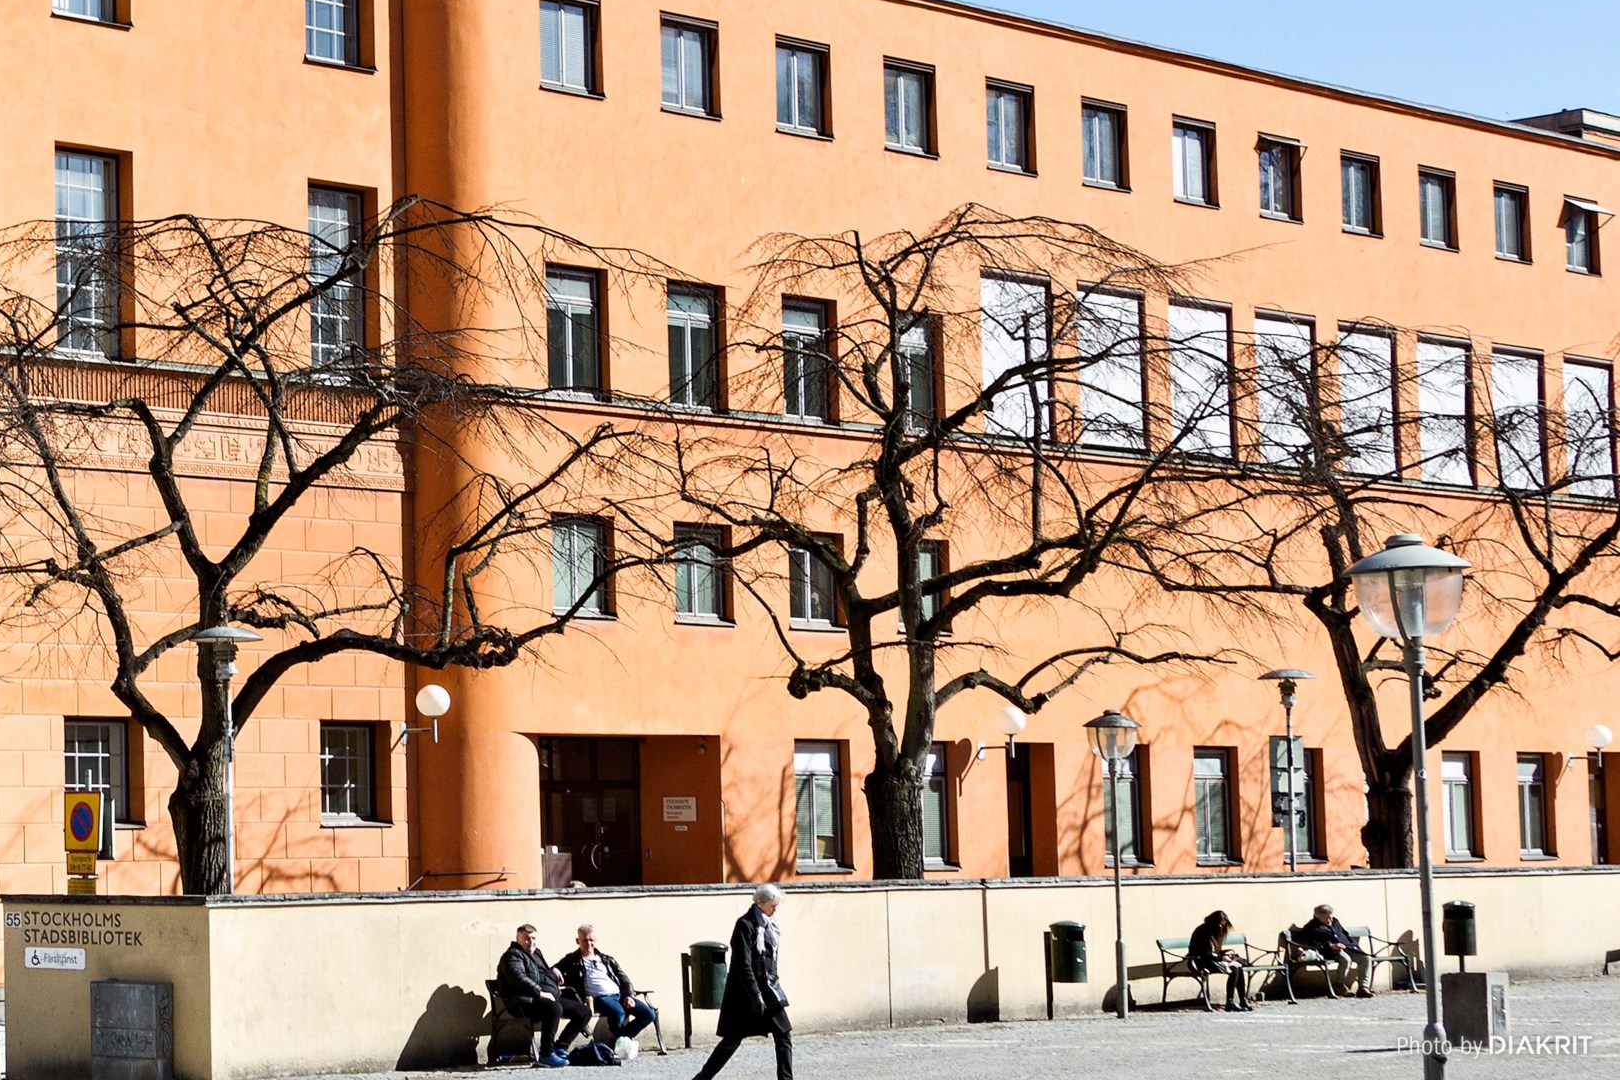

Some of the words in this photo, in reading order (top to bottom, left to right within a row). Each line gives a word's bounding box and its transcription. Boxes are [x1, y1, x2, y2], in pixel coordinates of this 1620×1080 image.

[6, 913, 21, 926] 55
[24, 911, 121, 927] STOCKHOLMS
[24, 929, 143, 946] STADSBIBLIOTEK
